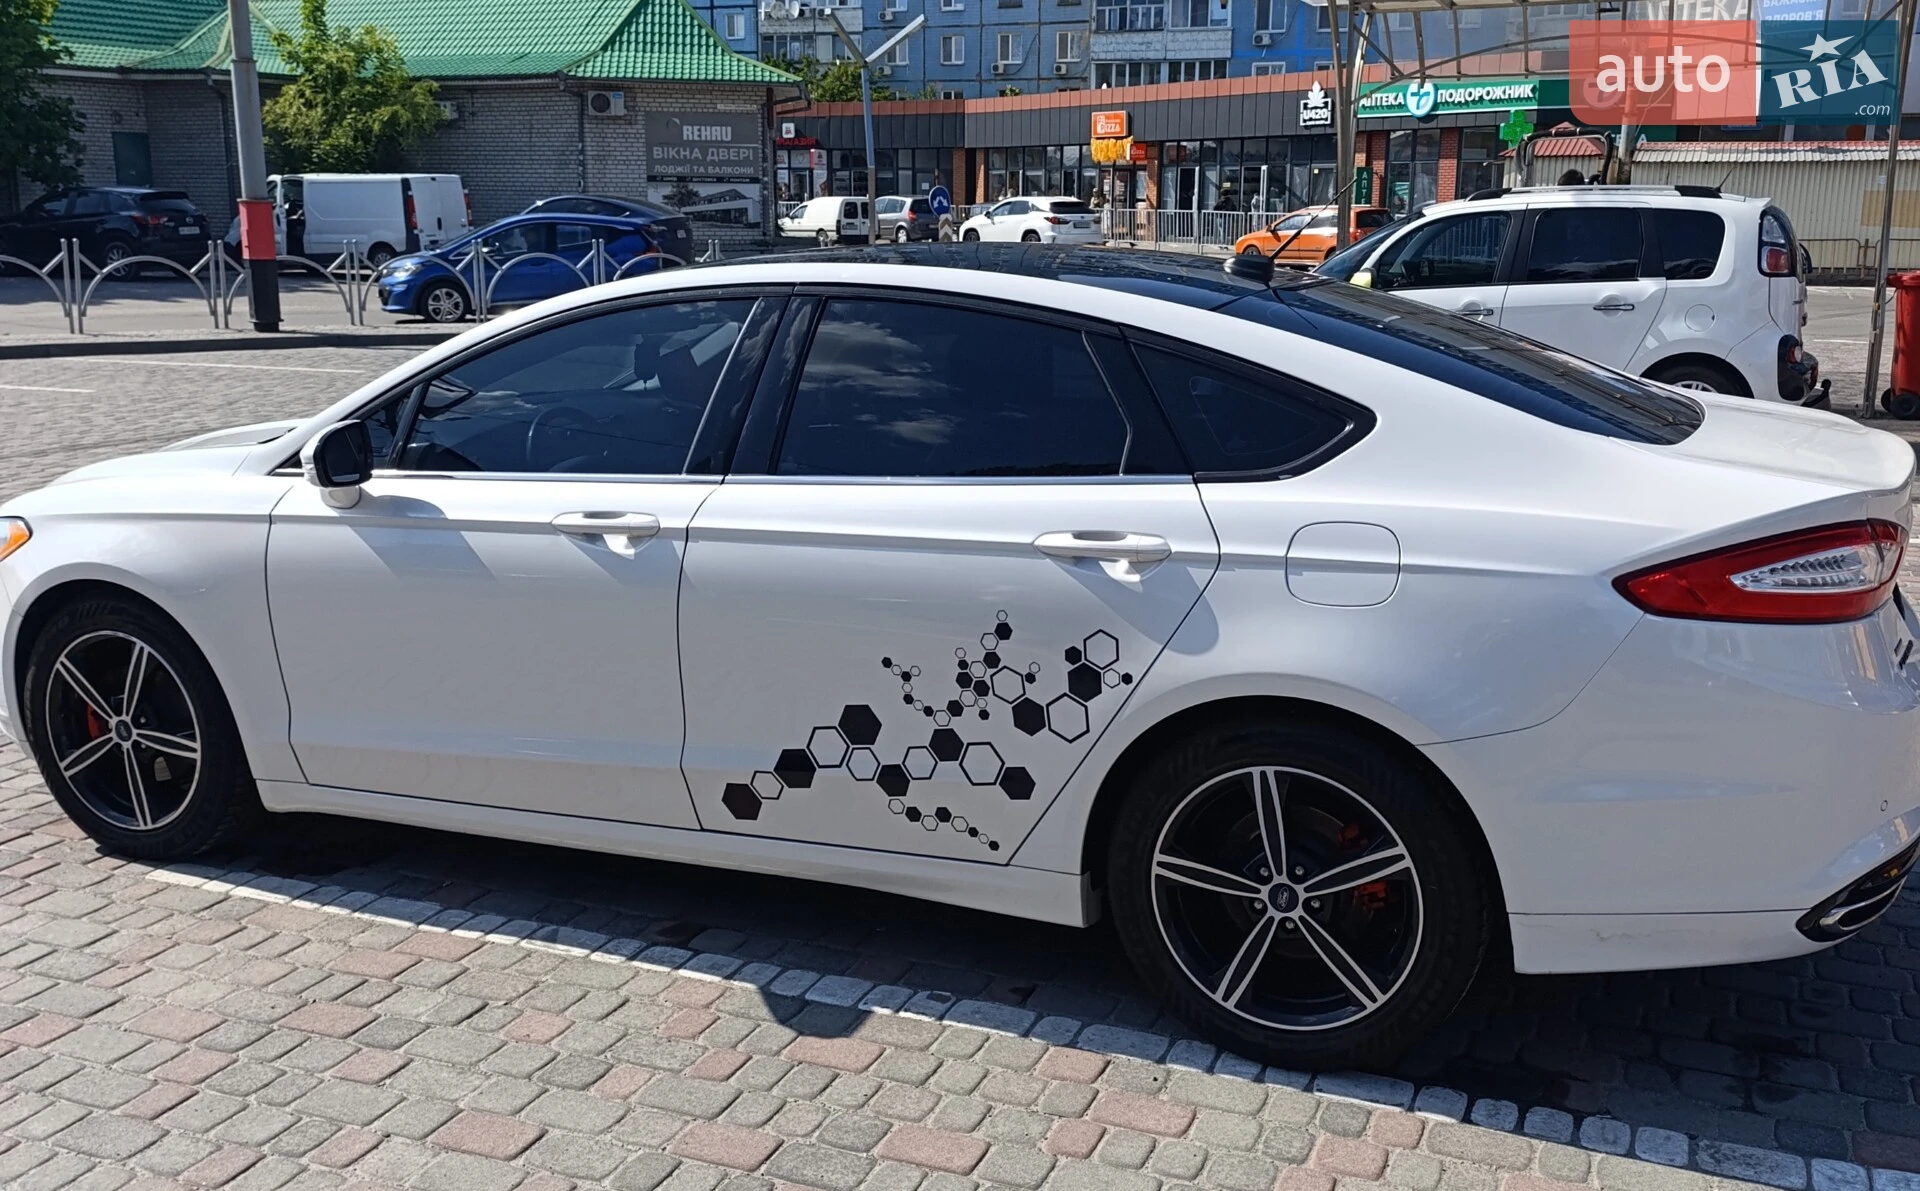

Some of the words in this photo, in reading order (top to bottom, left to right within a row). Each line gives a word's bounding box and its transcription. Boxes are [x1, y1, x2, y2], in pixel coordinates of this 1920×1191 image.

[1437, 84, 1534, 104] ПОДОРОЖНИК
[683, 125, 732, 141] REHAU
[652, 146, 702, 160] ВІКНА
[706, 148, 754, 162] ДВЕРІ
[654, 164, 691, 174] ЛОДЖІЇ
[692, 165, 706, 174] ТА
[707, 165, 754, 175] БАЛКОНИ
